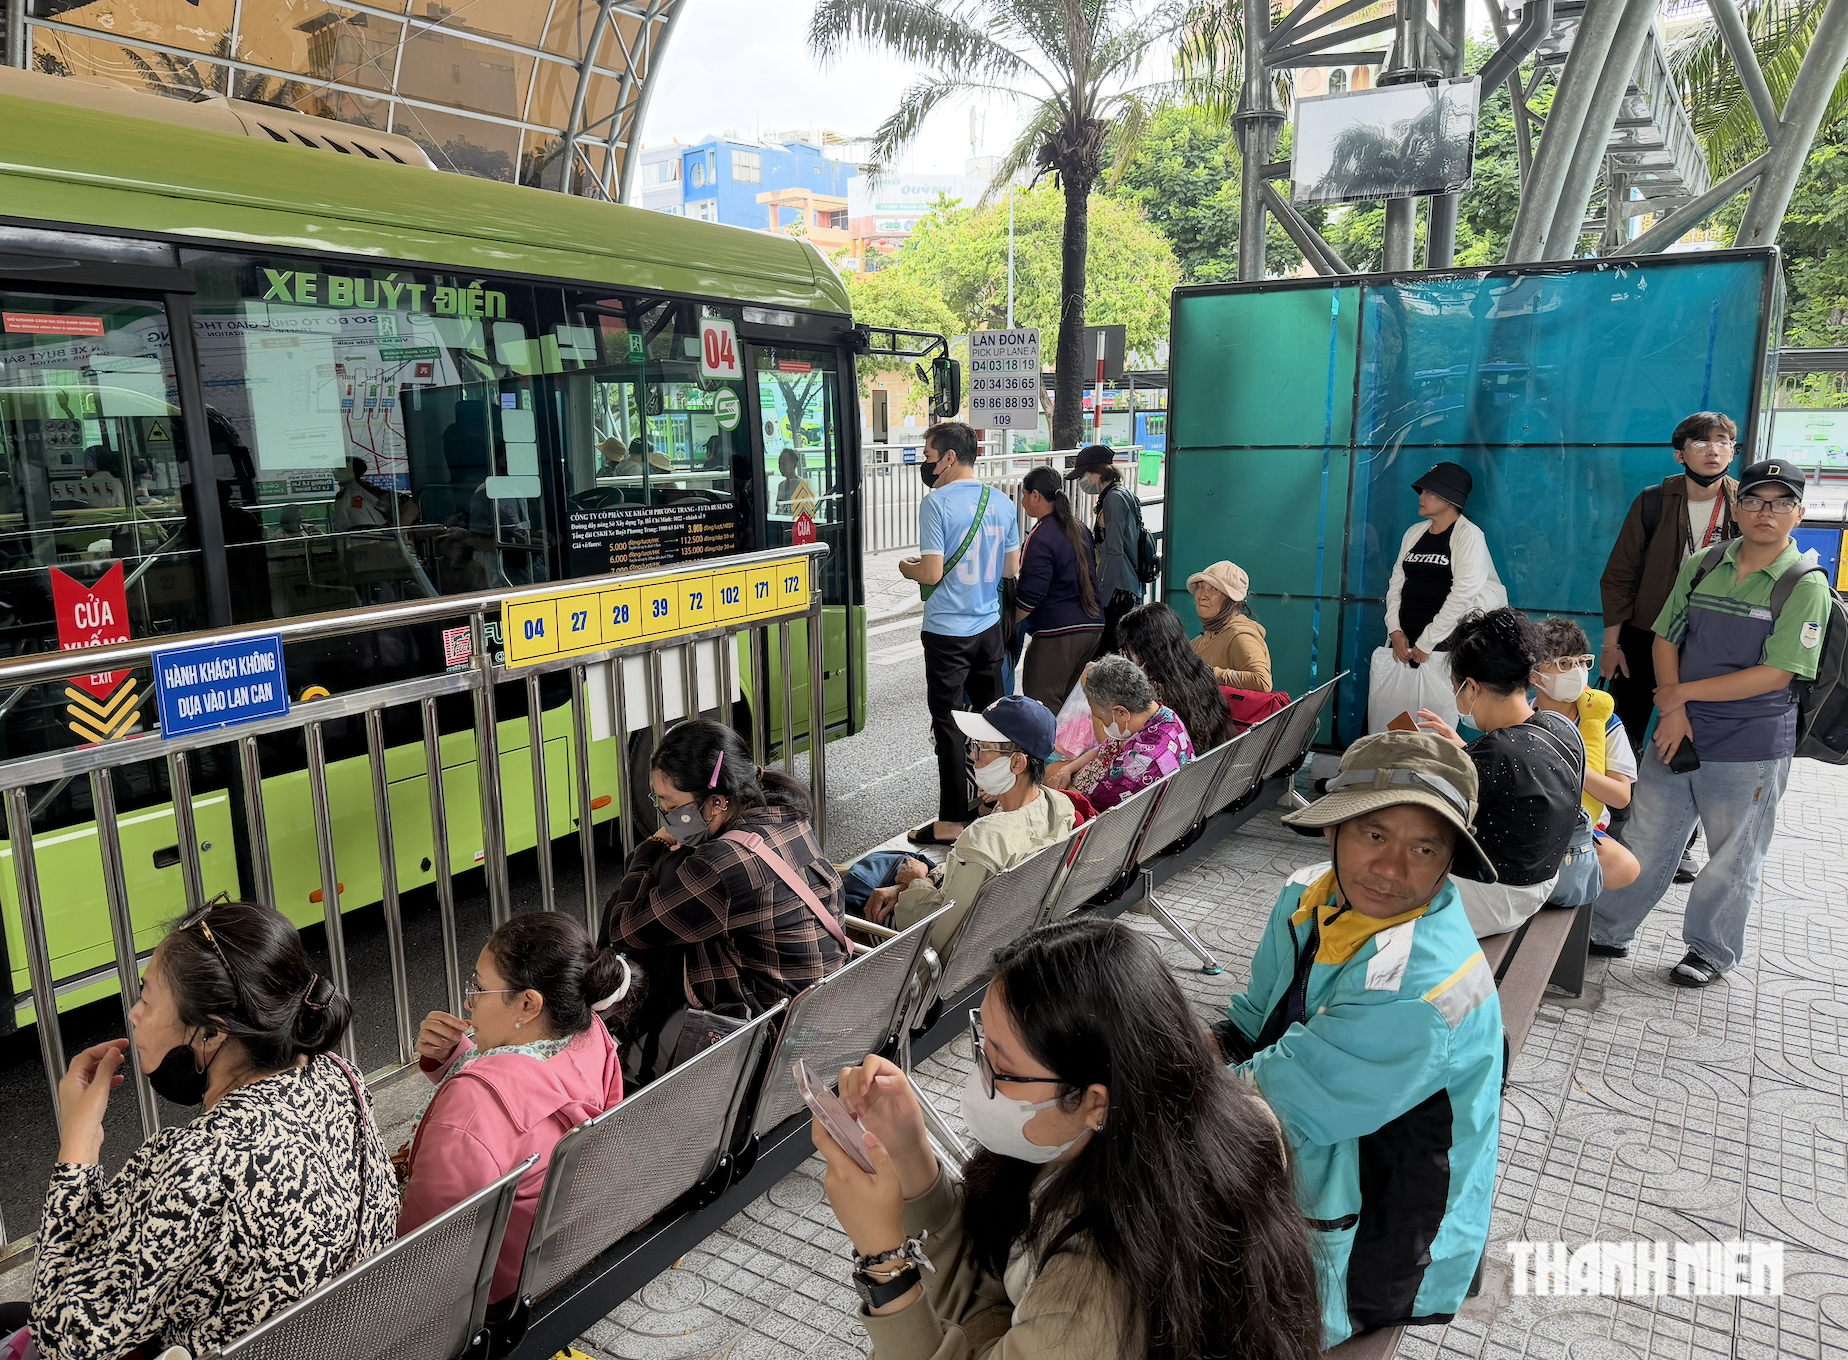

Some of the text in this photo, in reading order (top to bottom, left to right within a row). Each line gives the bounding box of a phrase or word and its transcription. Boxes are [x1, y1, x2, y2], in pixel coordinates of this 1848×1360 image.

[263, 268, 317, 302] XE
[328, 273, 426, 312] BUÝT
[973, 331, 1037, 346] LÀN ĐÓN A
[704, 328, 735, 370] 04
[972, 346, 1037, 357] PICK UP LANE A
[972, 359, 1034, 371] D4 03 18 19
[973, 378, 1034, 390] 20 34 36 65
[973, 398, 1034, 408] 69 86 88 93
[994, 415, 1011, 425] 109
[1766, 464, 1781, 476] D
[633, 508, 654, 517] KHÁCH
[677, 506, 694, 514] TRANG
[698, 504, 710, 512] FUTA
[710, 503, 734, 511] BUSLINES
[688, 524, 703, 534] 3.000
[798, 516, 811, 536] CỬA
[609, 542, 627, 552] 5.000
[680, 534, 703, 544] 112.500
[610, 554, 628, 564] 6.000
[680, 546, 704, 556] 135.000
[74, 594, 114, 629] CỬA
[524, 575, 800, 640] 04 27 28 39 72 102 171 172
[164, 650, 276, 690] HÀNH KHÁCH KHÔNG
[178, 682, 274, 720] DỰA VÀO LAN CAN
